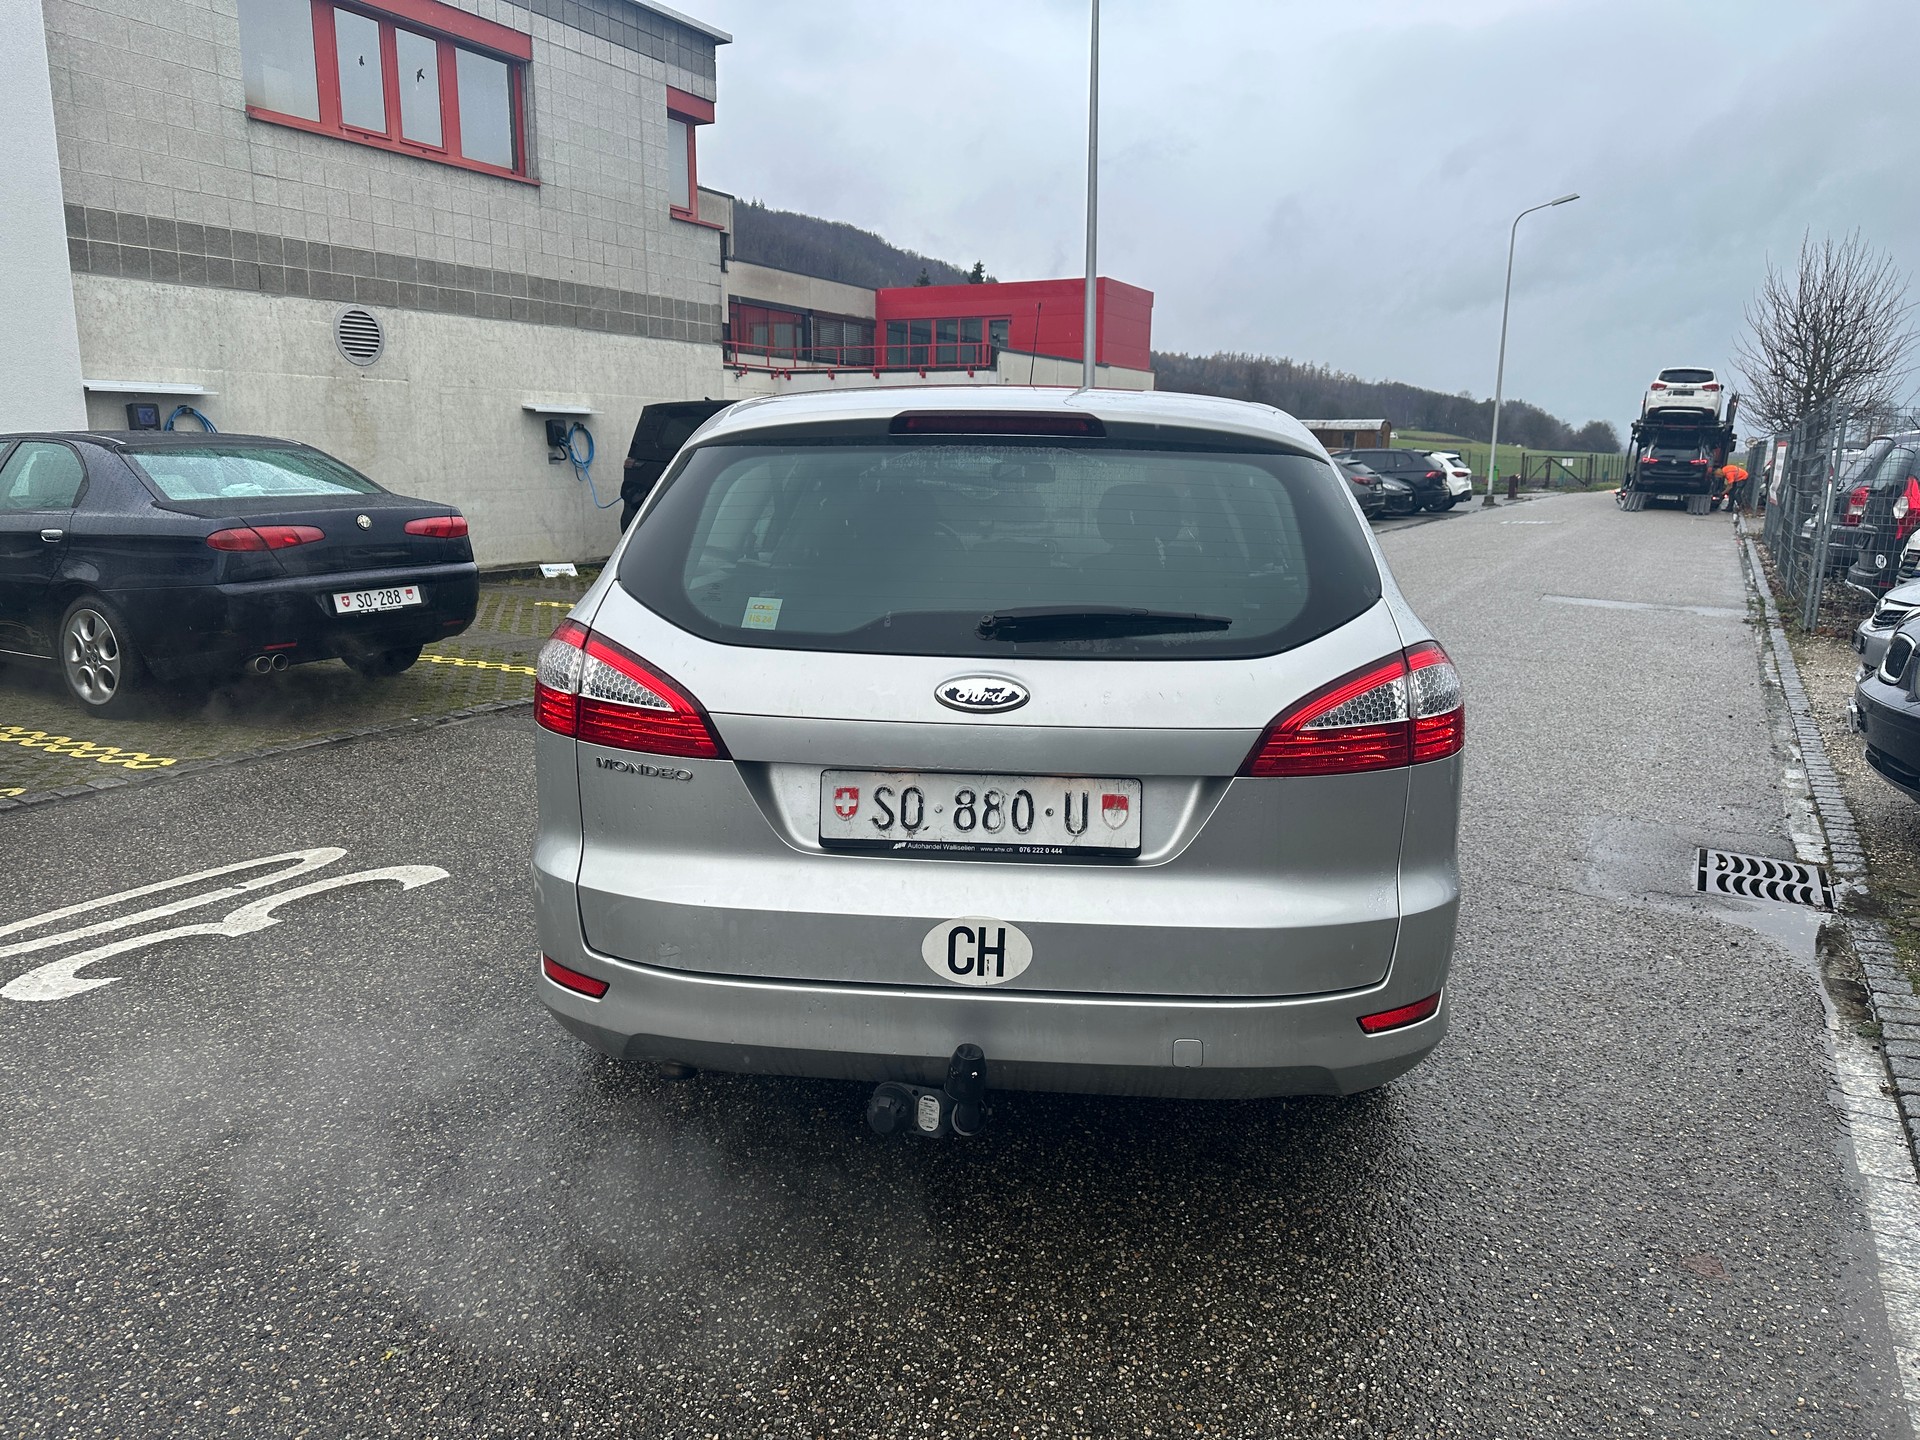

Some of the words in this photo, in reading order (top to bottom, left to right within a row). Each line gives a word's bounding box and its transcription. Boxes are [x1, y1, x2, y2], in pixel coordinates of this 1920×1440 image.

[955, 683, 1012, 703] Ford
[595, 756, 694, 781] MONDEO
[907, 842, 942, 851] Autohandel
[1018, 846, 1031, 854] 076
[1050, 847, 1063, 855] 444
[947, 926, 1006, 977] CH
